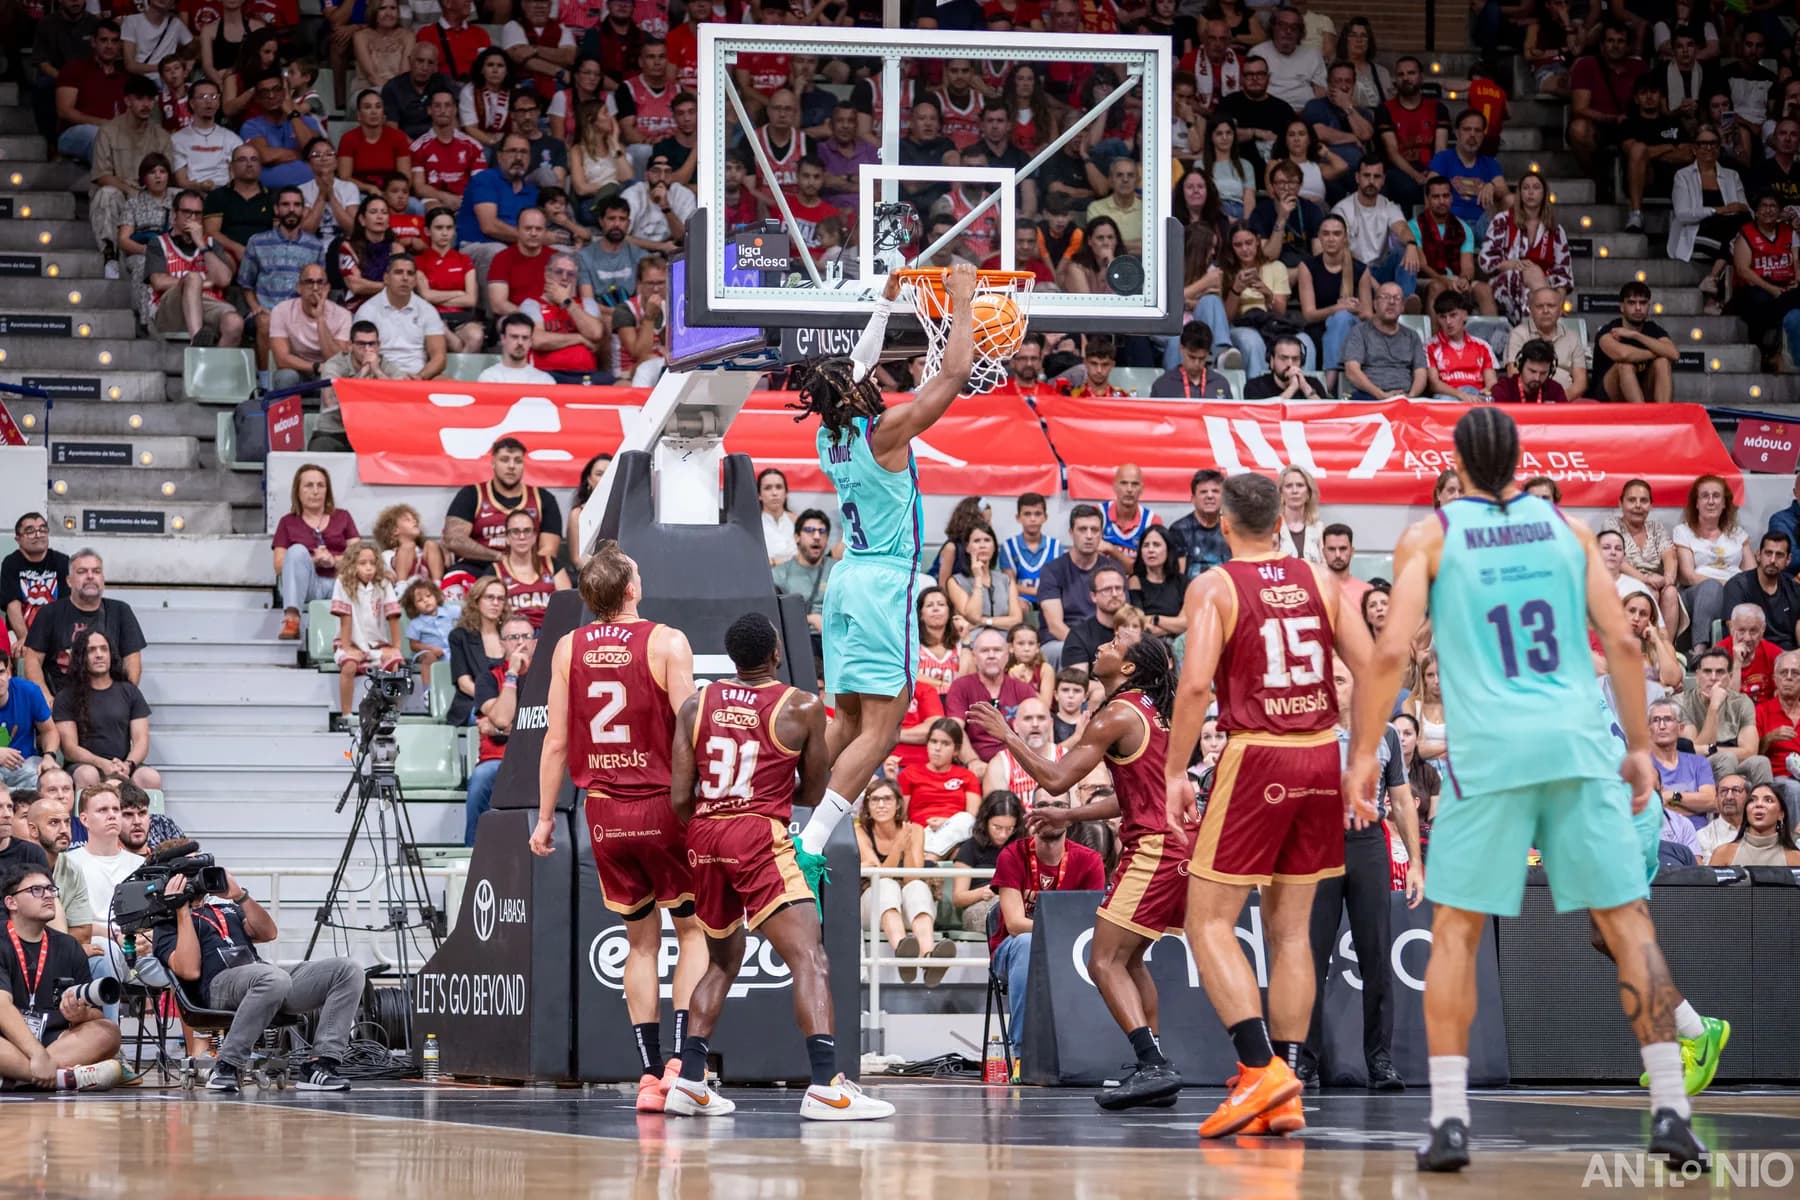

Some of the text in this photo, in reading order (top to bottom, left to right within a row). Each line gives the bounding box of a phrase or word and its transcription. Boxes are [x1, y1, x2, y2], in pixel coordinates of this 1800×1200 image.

[738, 244, 761, 258] liga
[738, 256, 787, 267] endesa
[1547, 451, 1590, 469] DE
[1743, 435, 1792, 451] MÓDULO
[1760, 452, 1769, 463] 6
[842, 502, 870, 551] 3
[1259, 616, 1325, 688] 15
[1486, 599, 1560, 678] 13
[587, 681, 631, 744] 2
[701, 736, 760, 799] 31
[499, 898, 526, 923] LABASA
[416, 973, 526, 1016] LET'S GO BEYOND
